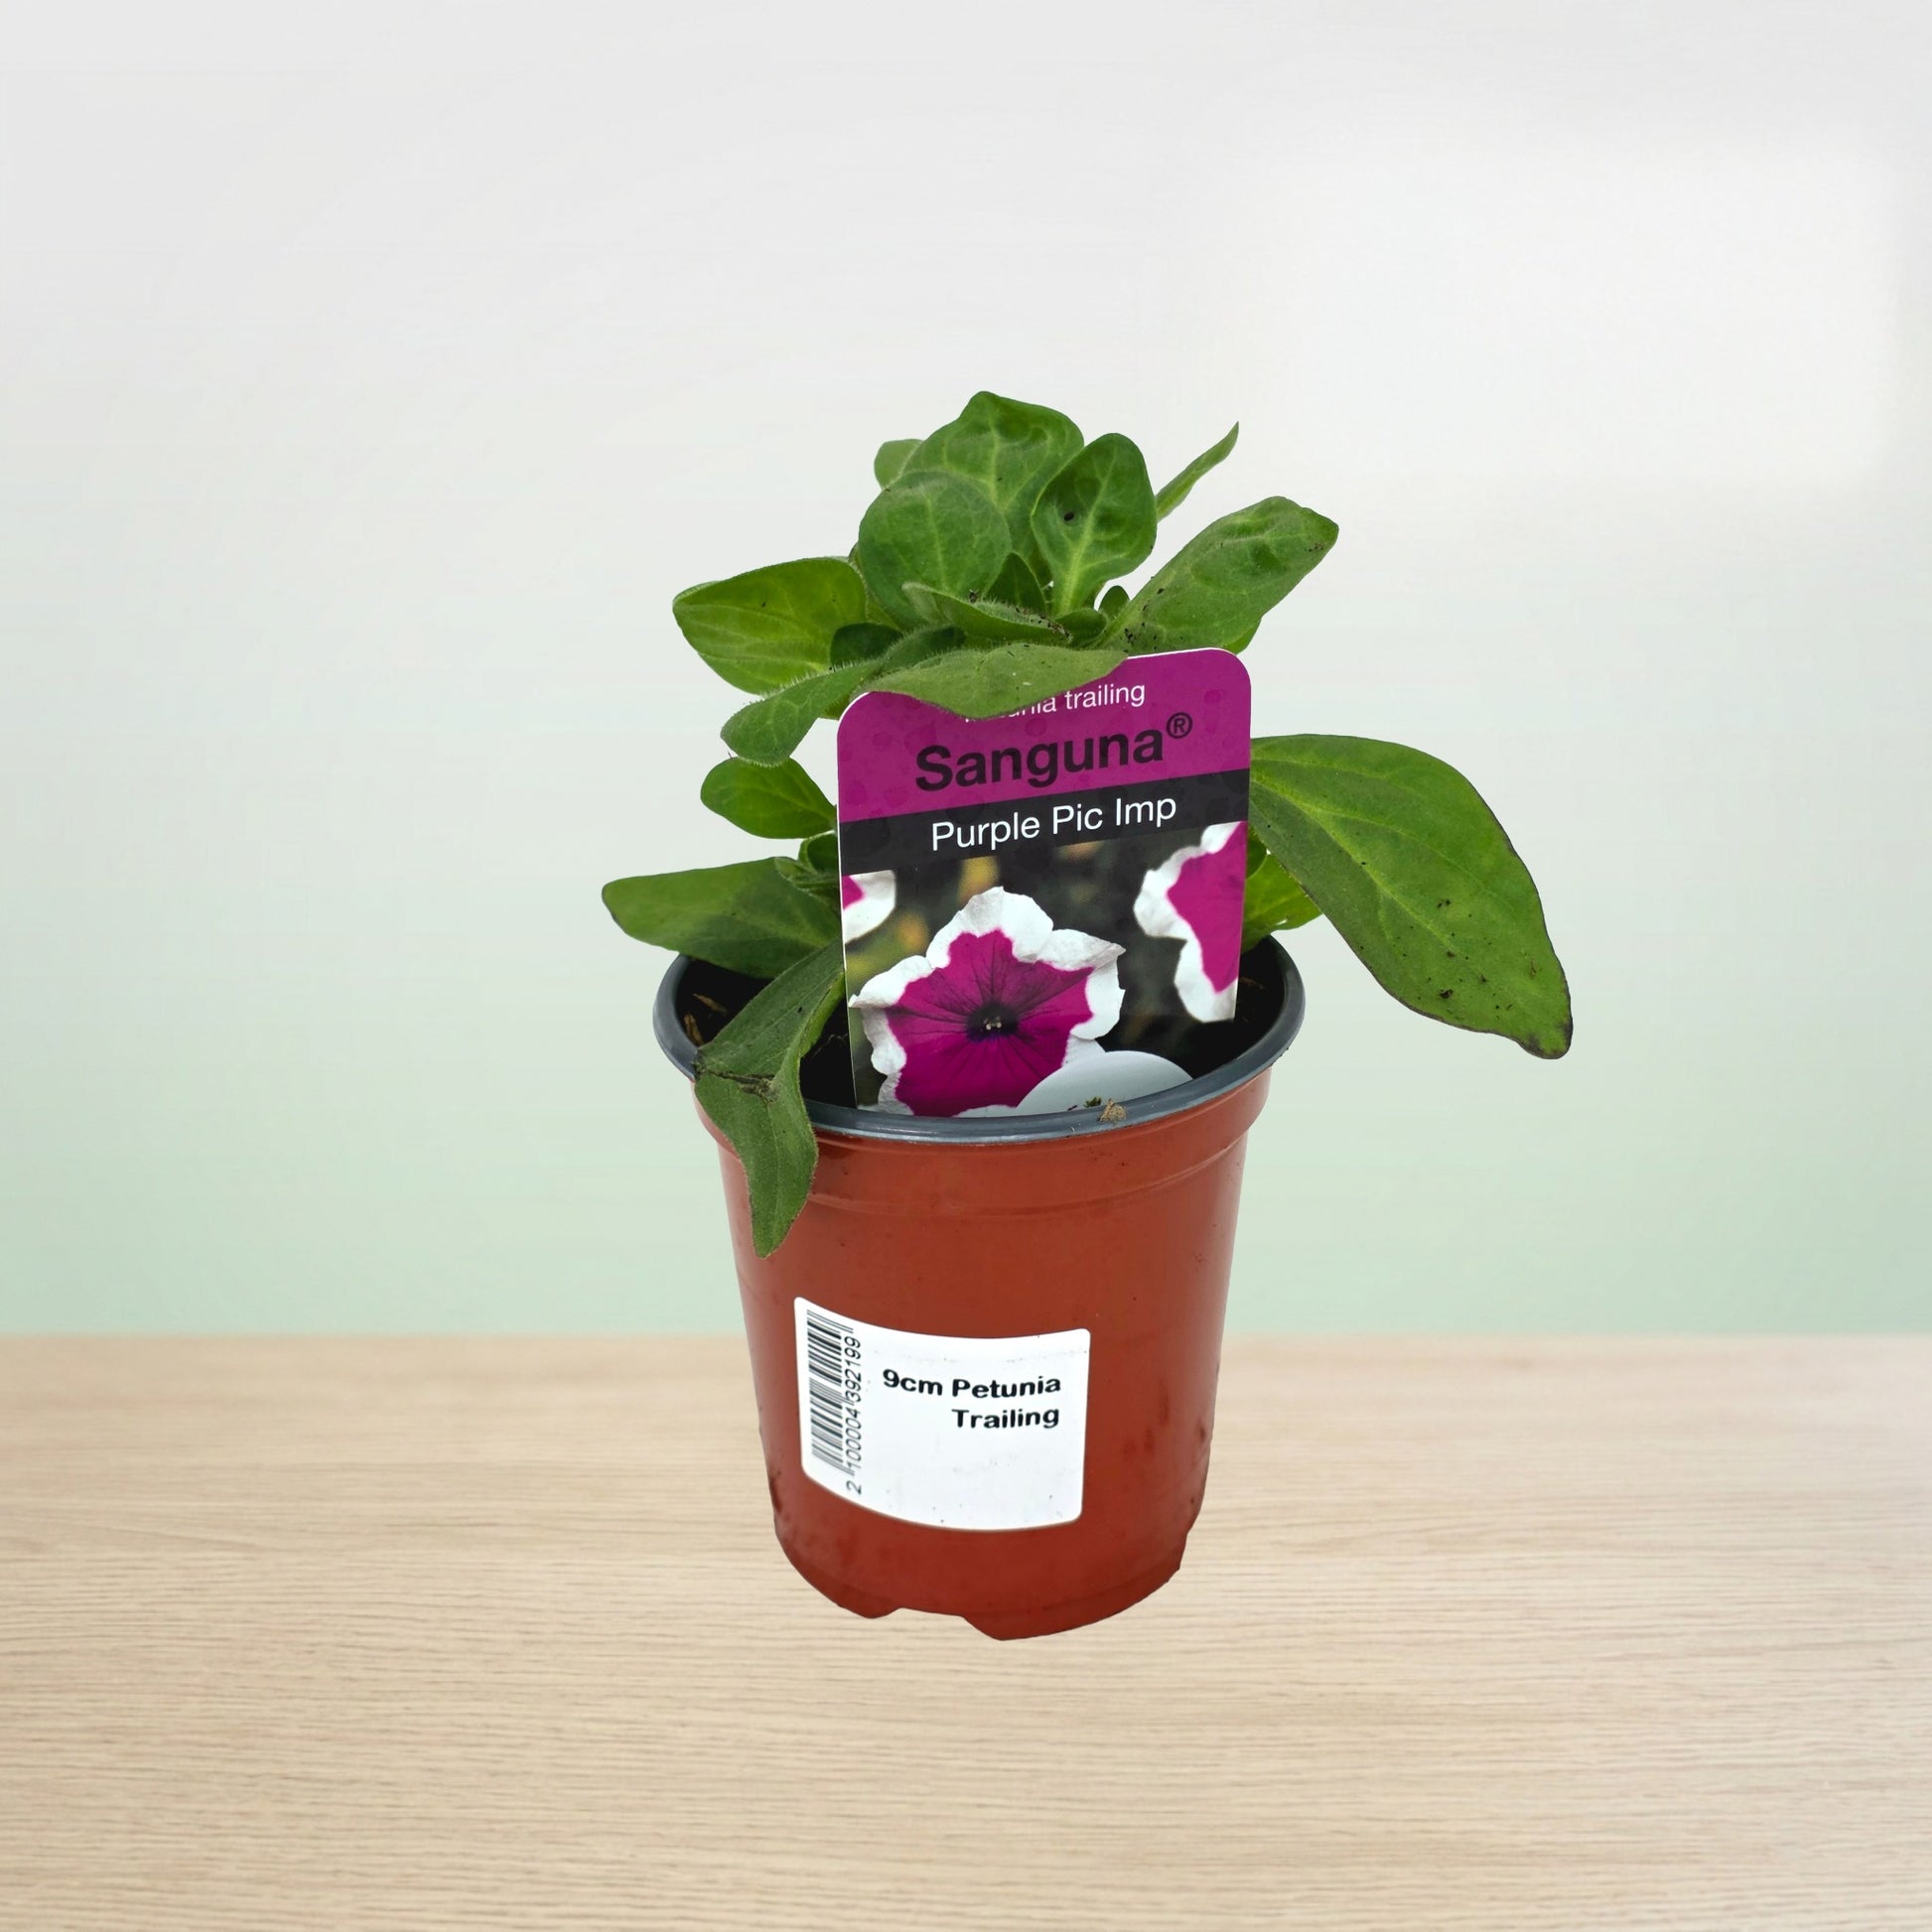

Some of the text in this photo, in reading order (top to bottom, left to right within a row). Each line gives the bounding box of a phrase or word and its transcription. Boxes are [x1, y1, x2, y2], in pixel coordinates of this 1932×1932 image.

[1063, 683, 1146, 708] trailing
[931, 797, 1175, 851] Purple Pic Imp
[883, 1369, 1061, 1399] 9cm Petunia
[951, 1409, 1059, 1429] Trailing
